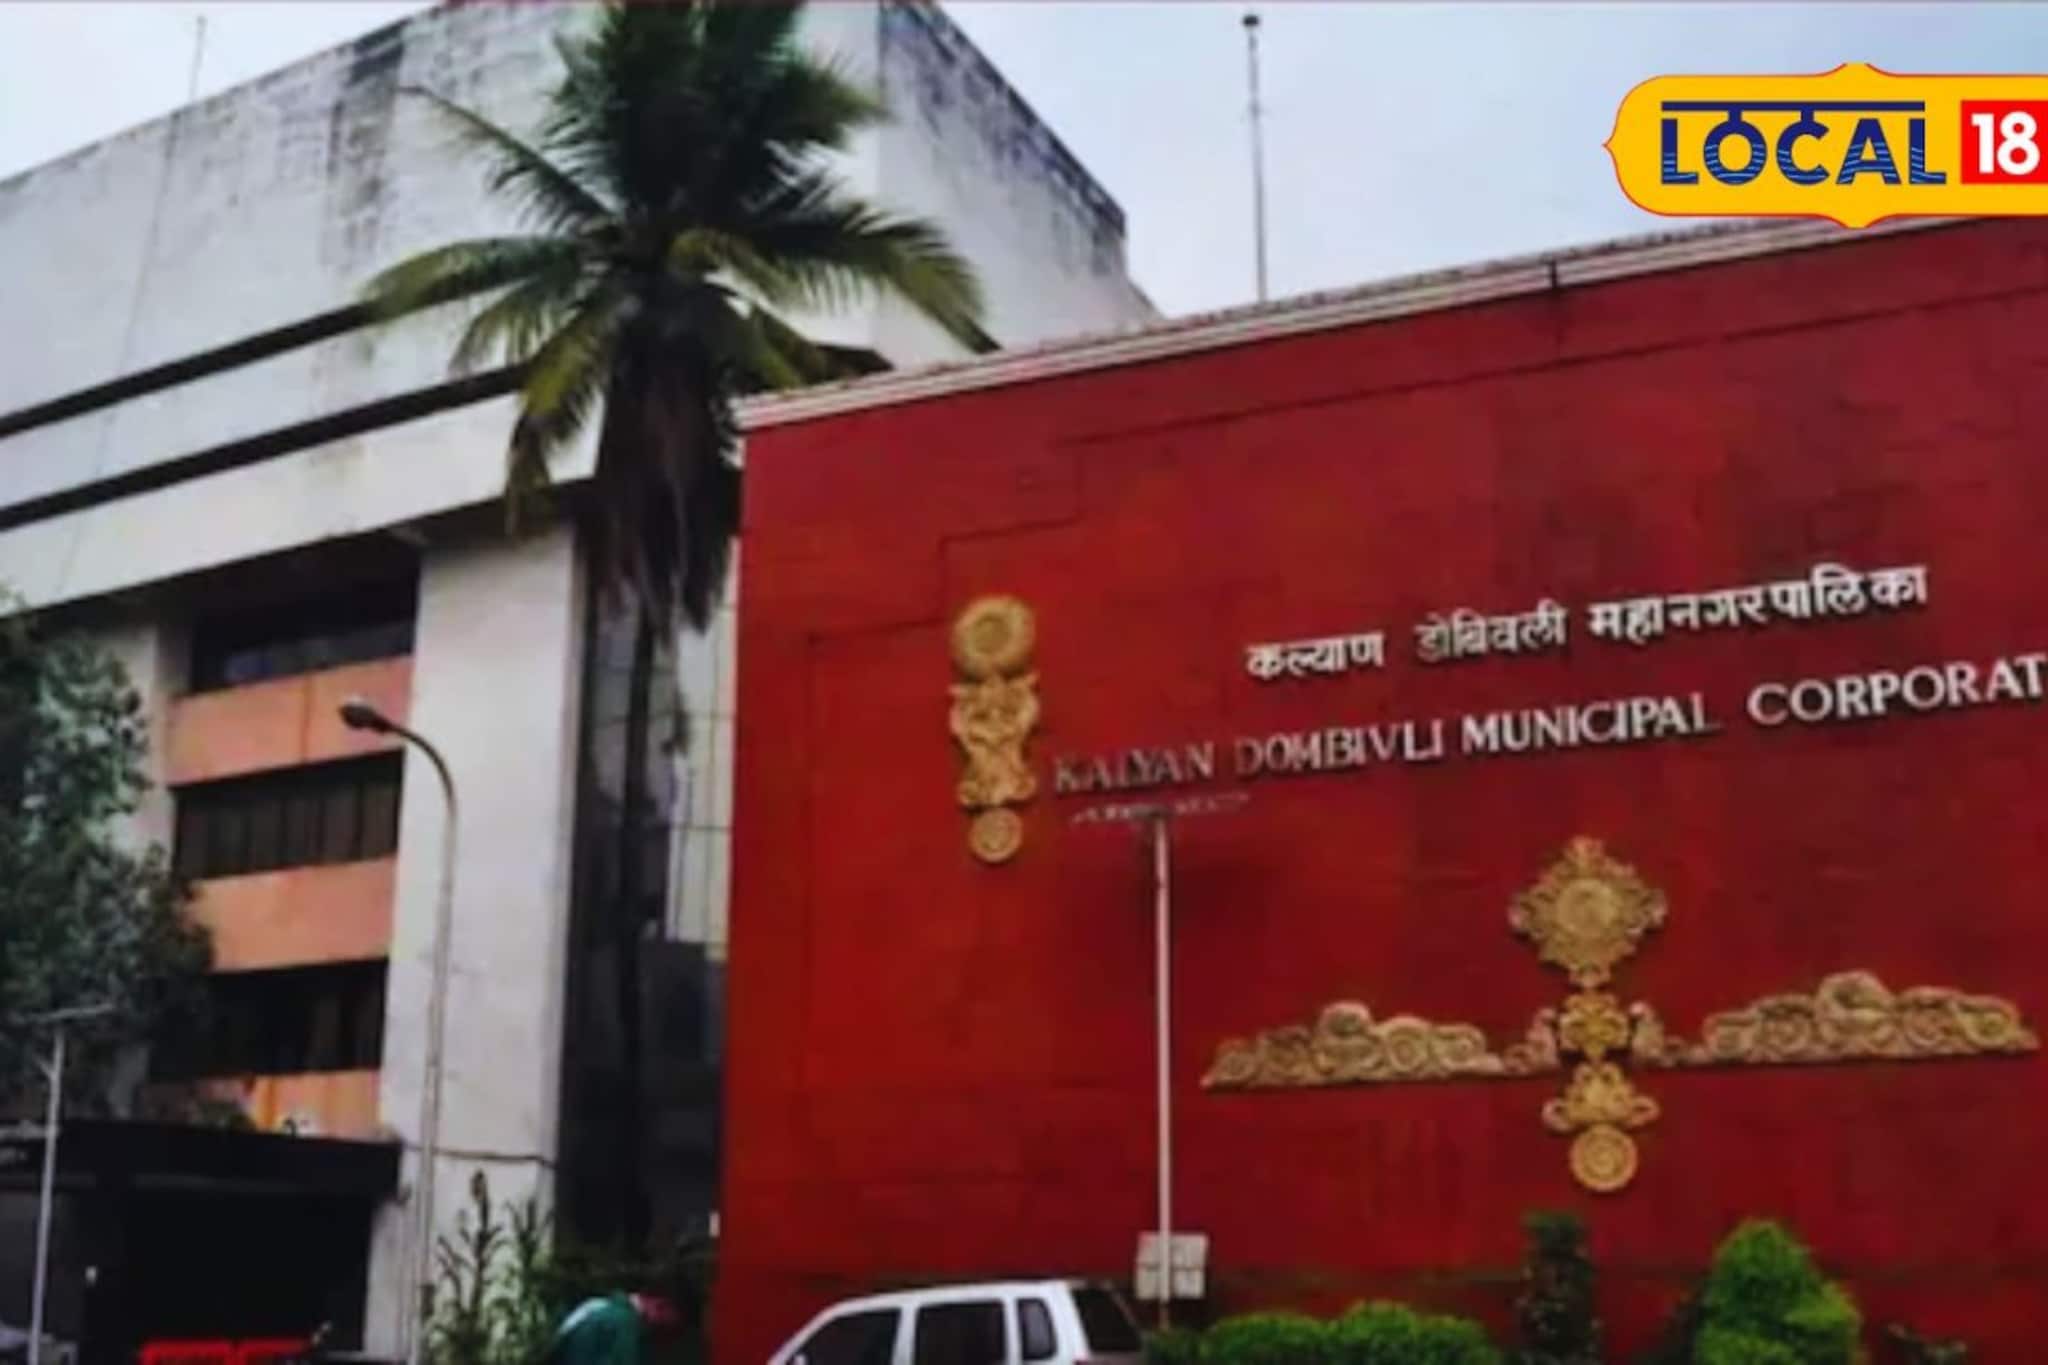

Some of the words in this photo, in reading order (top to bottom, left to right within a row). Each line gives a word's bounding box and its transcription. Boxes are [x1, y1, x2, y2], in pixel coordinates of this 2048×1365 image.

[1245, 631, 1386, 679] कल्याण
[1589, 562, 1928, 643] महानगरपालिका
[1054, 741, 1215, 792] KALYAN
[1234, 718, 1443, 777] DOMBIVLI
[1461, 691, 1722, 755] MUNICIPAL
